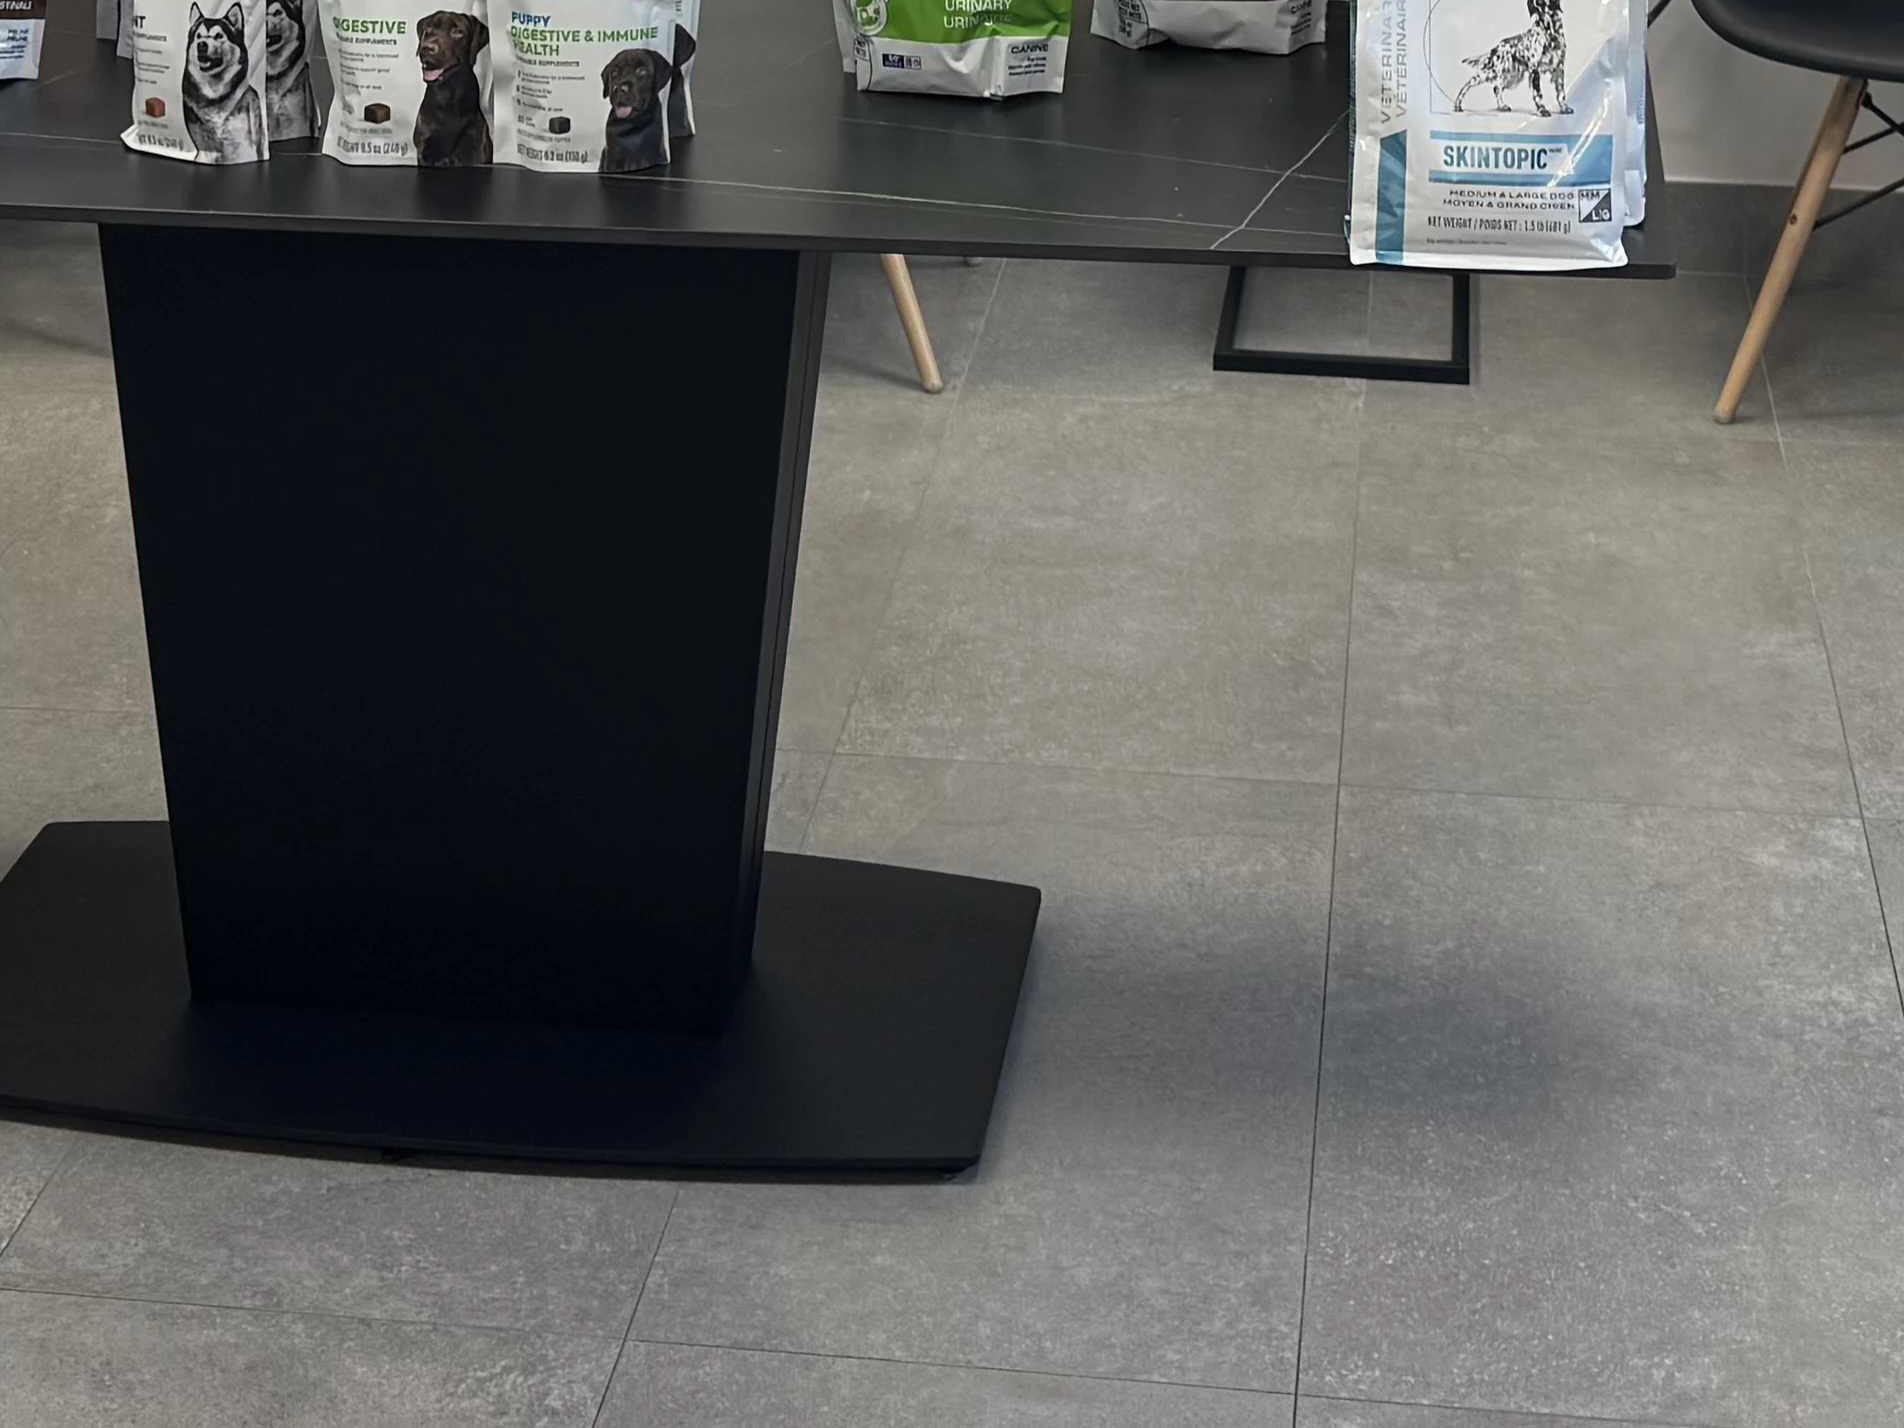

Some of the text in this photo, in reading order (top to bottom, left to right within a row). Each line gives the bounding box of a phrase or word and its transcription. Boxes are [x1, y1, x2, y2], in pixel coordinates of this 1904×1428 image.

[511, 11, 551, 28] PUPPY
[510, 26, 659, 43] DIGESTIVE & IMMUNE
[1443, 144, 1548, 170] SKINTOPIC
